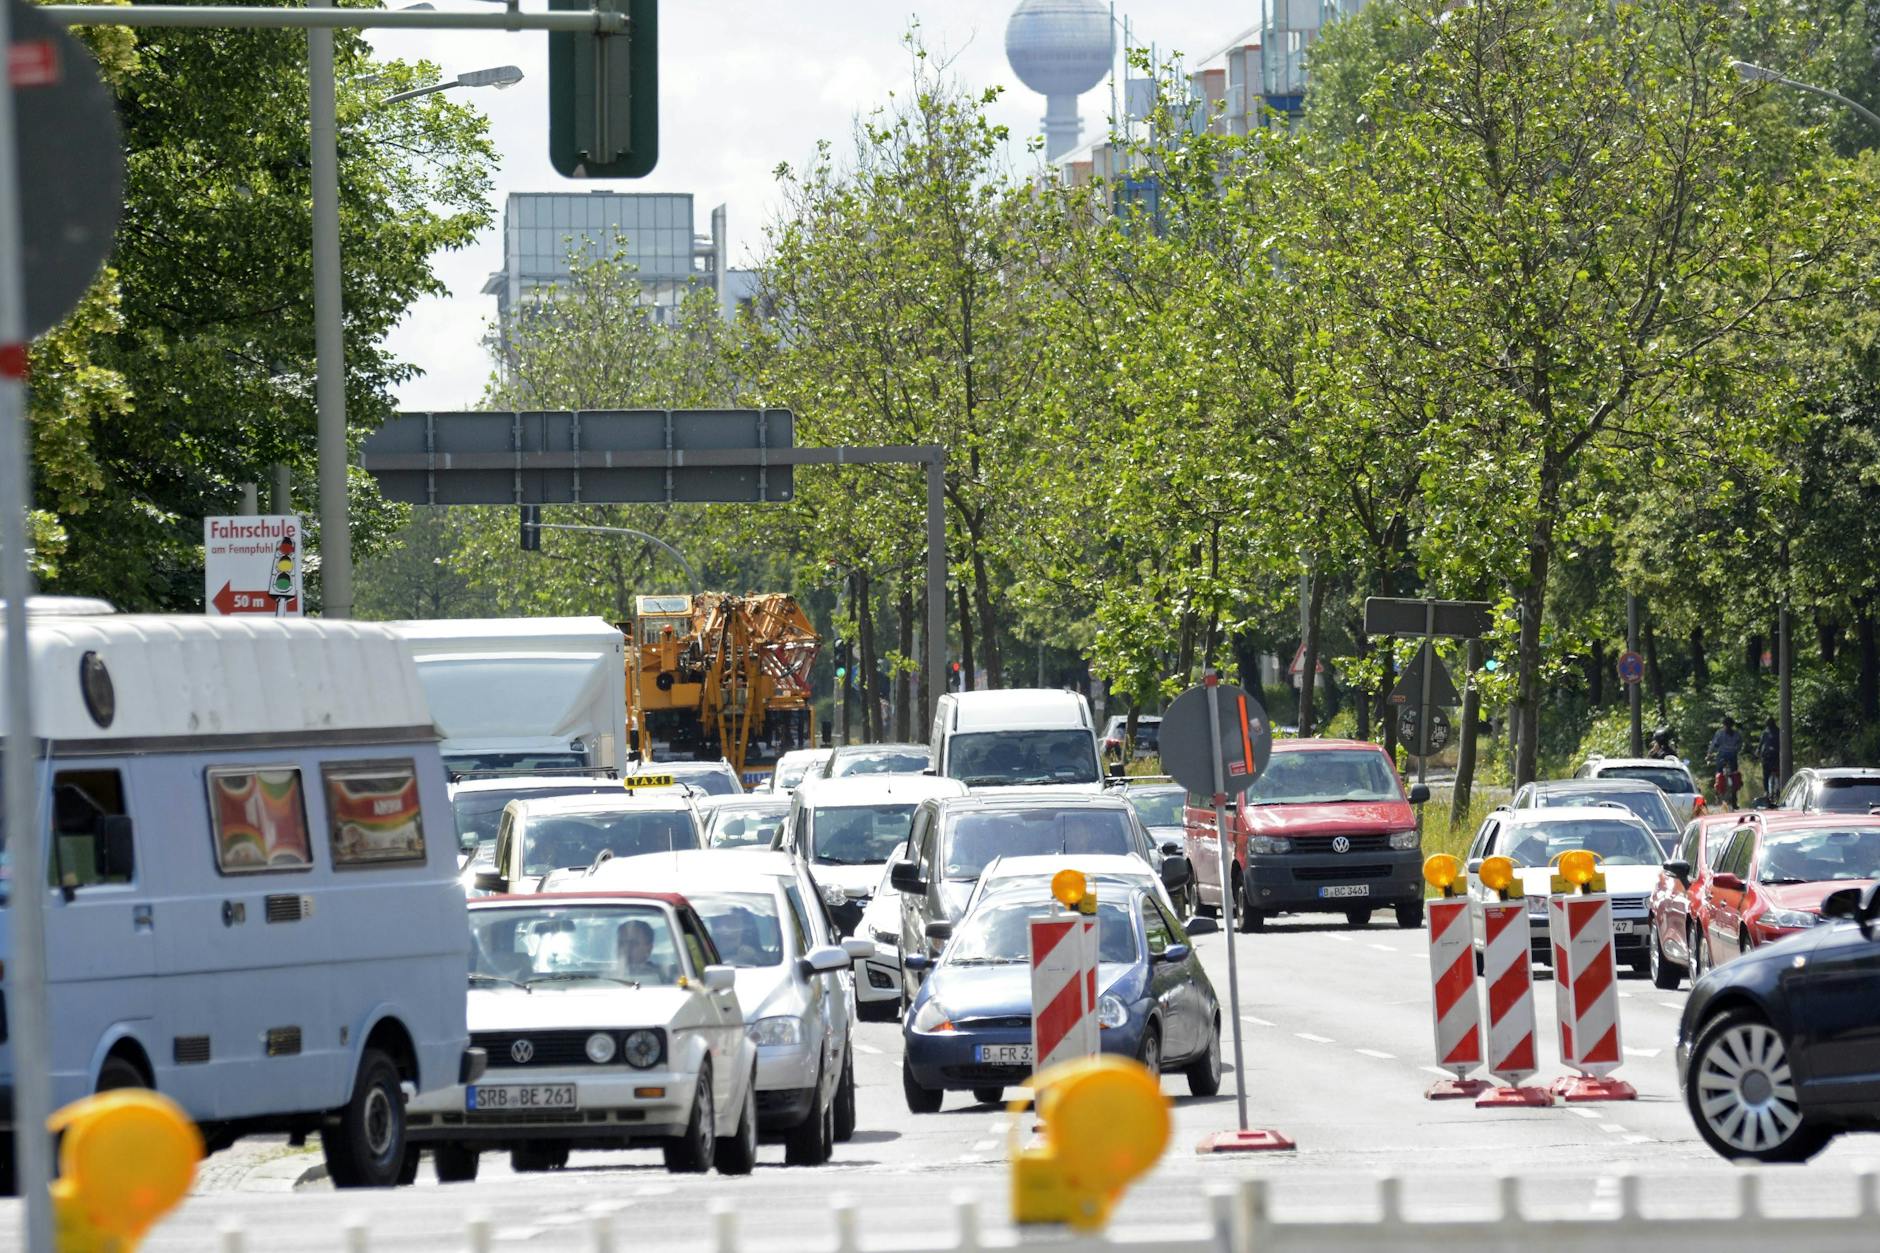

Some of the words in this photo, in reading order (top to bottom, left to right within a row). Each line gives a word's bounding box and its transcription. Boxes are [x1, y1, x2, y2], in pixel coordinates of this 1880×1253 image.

[211, 519, 296, 539] Fahrschule
[211, 546, 226, 554] am
[228, 543, 274, 556] Fennpfuhl
[233, 594, 249, 608] 50
[252, 597, 265, 608] m
[631, 776, 666, 786] TAXI
[1323, 887, 1329, 896] B
[1334, 887, 1346, 896] BC
[1347, 886, 1368, 896] 3461
[982, 1047, 992, 1060] B
[1000, 1047, 1017, 1060] FR
[478, 1088, 508, 1107] SRB
[520, 1088, 540, 1106] BE
[544, 1087, 573, 1105] 261
